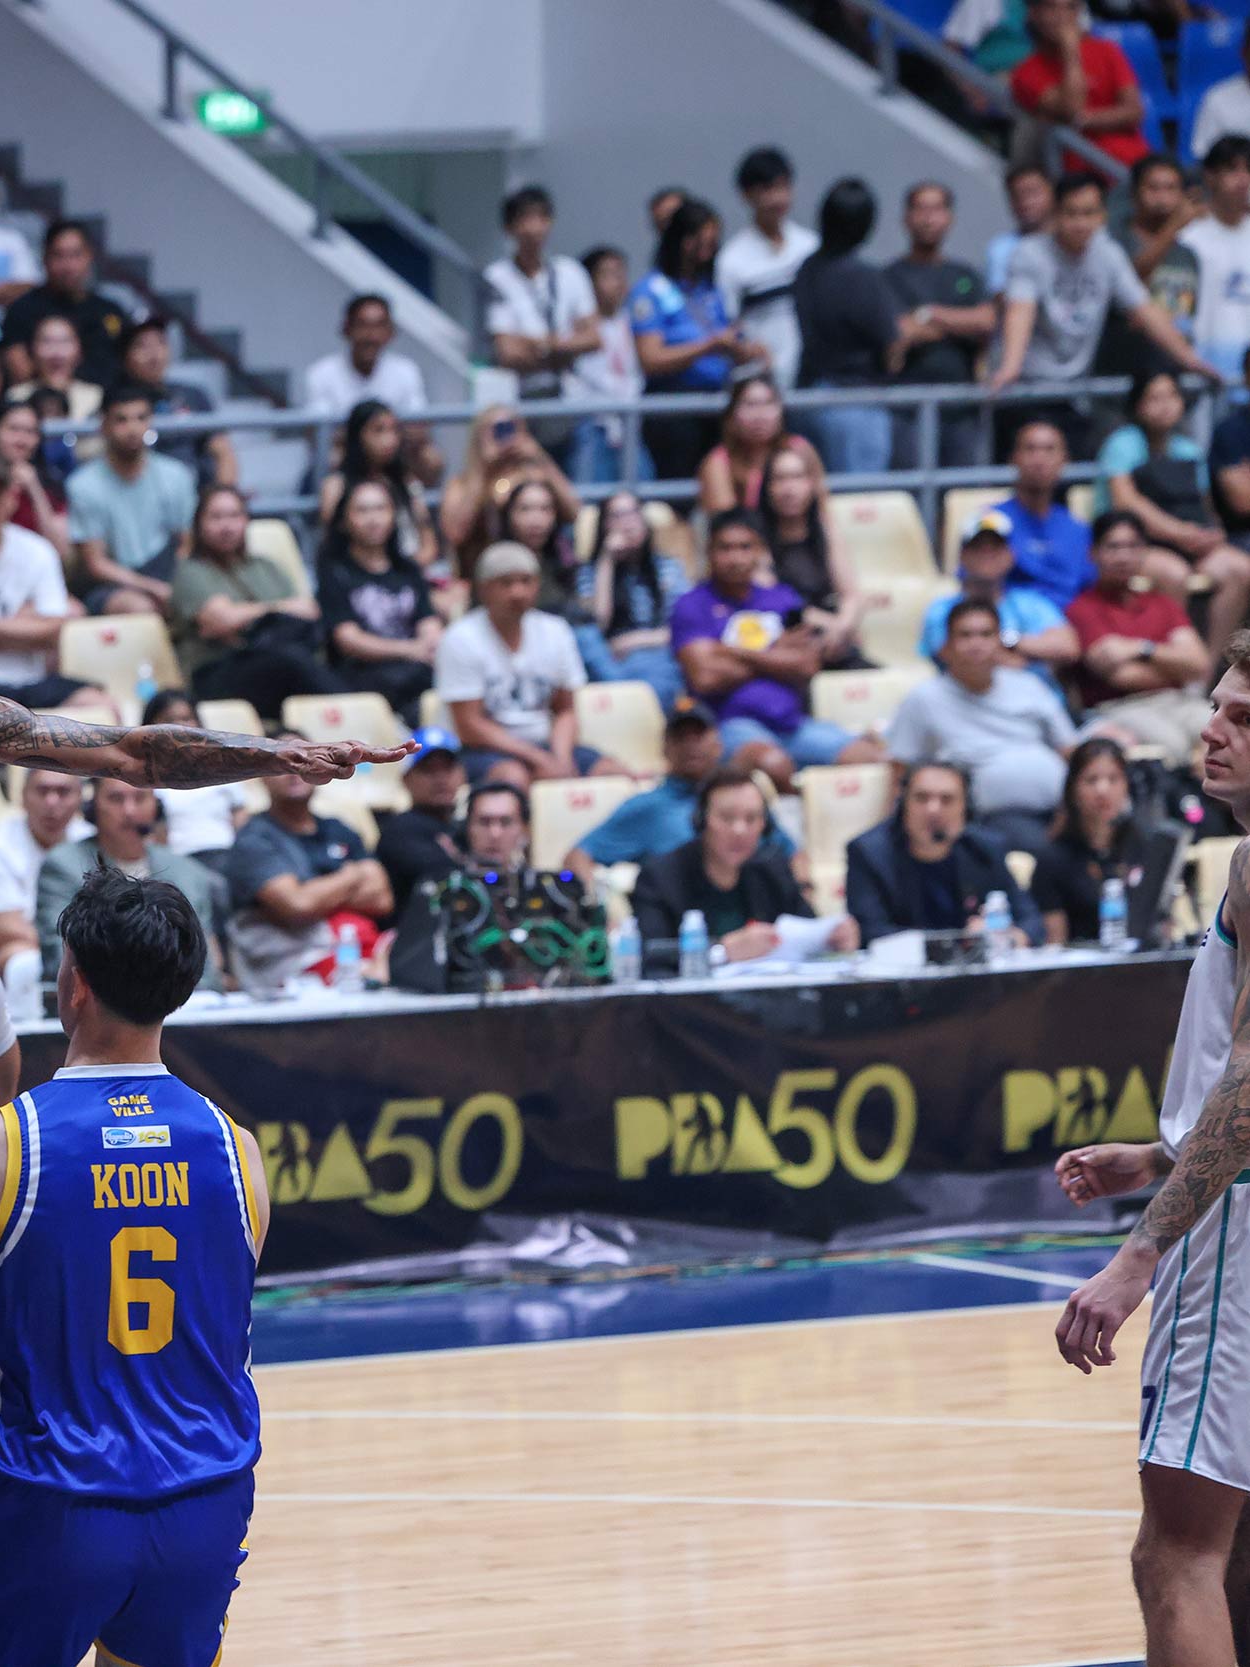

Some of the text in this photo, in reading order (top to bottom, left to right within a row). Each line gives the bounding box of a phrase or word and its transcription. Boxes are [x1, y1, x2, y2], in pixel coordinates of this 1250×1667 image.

[107, 1094, 150, 1106] GAME
[111, 1105, 155, 1117] VILLE
[614, 1063, 918, 1190] PBA50
[1002, 1043, 1174, 1153] PBA
[90, 1161, 190, 1209] KOON
[256, 1091, 524, 1216] BA50
[107, 1226, 178, 1356] 6
